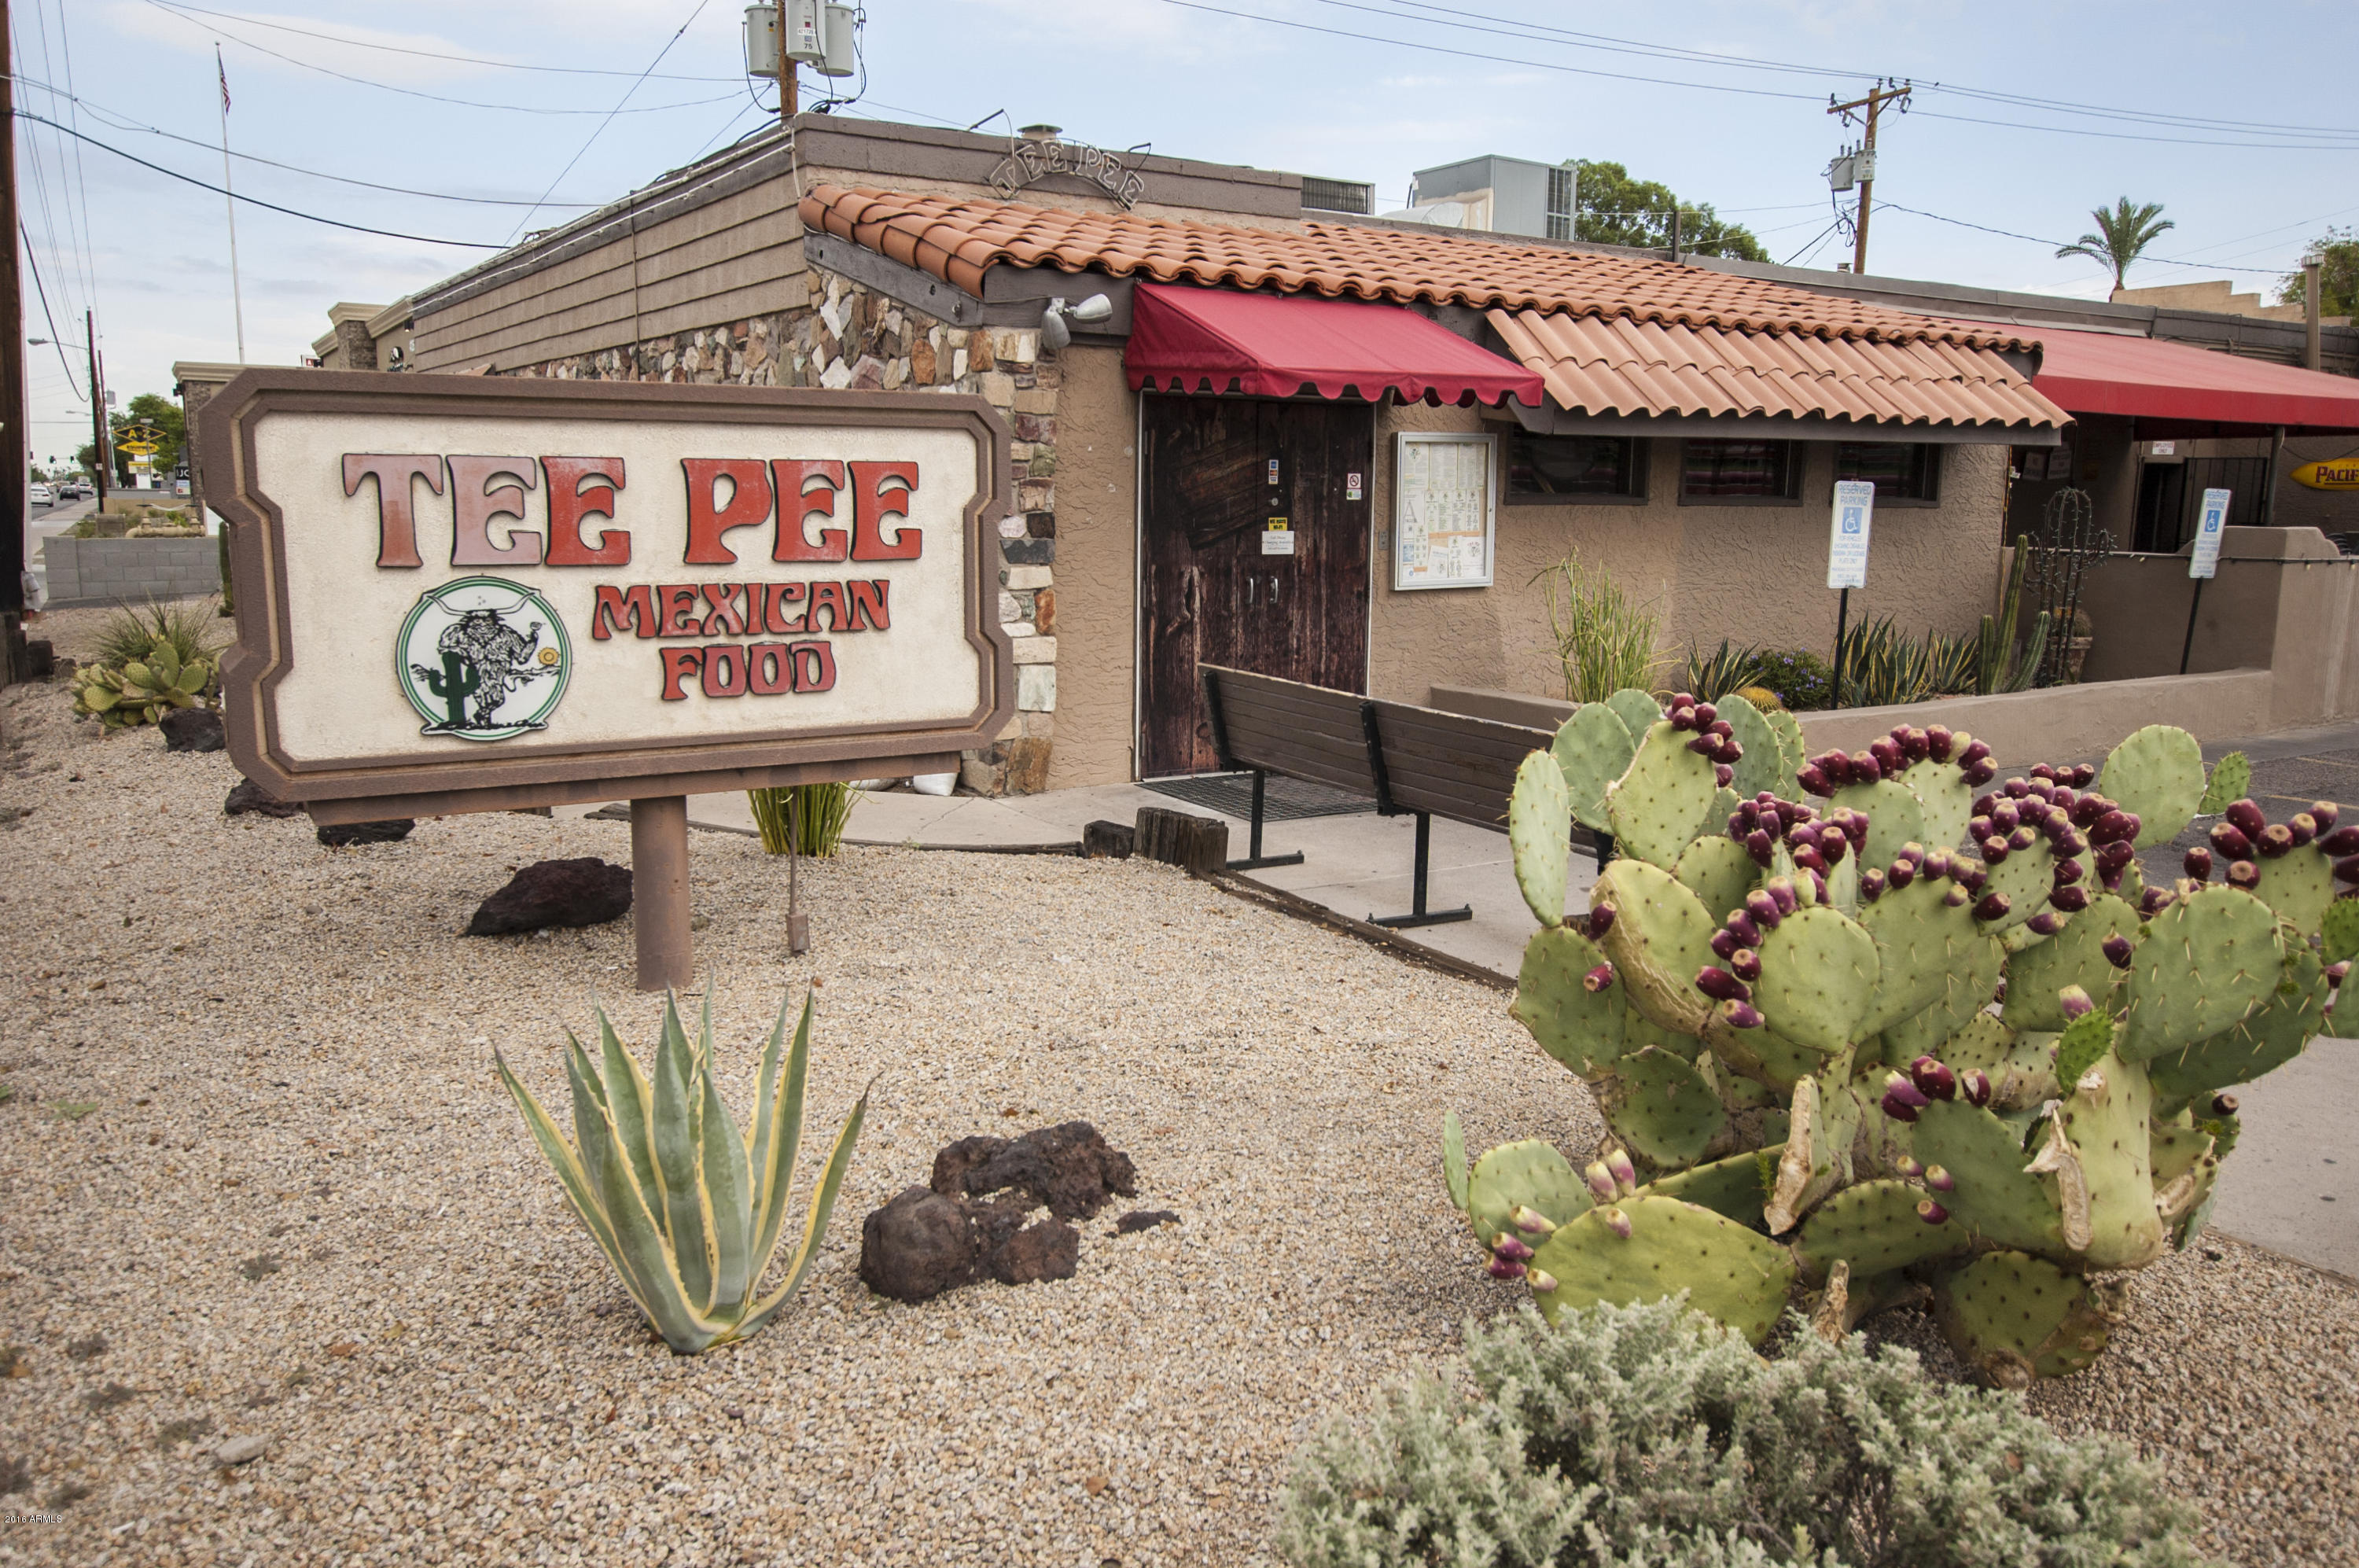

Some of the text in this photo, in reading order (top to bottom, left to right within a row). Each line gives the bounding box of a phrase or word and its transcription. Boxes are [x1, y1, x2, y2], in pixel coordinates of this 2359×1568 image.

[989, 138, 1145, 206] TEE PEE
[342, 452, 922, 568] TEE PEE
[1838, 484, 1871, 495] RESERVED
[1840, 495, 1868, 506] PARKING
[592, 579, 892, 640] MEXICAN
[660, 640, 837, 701] FOOD
